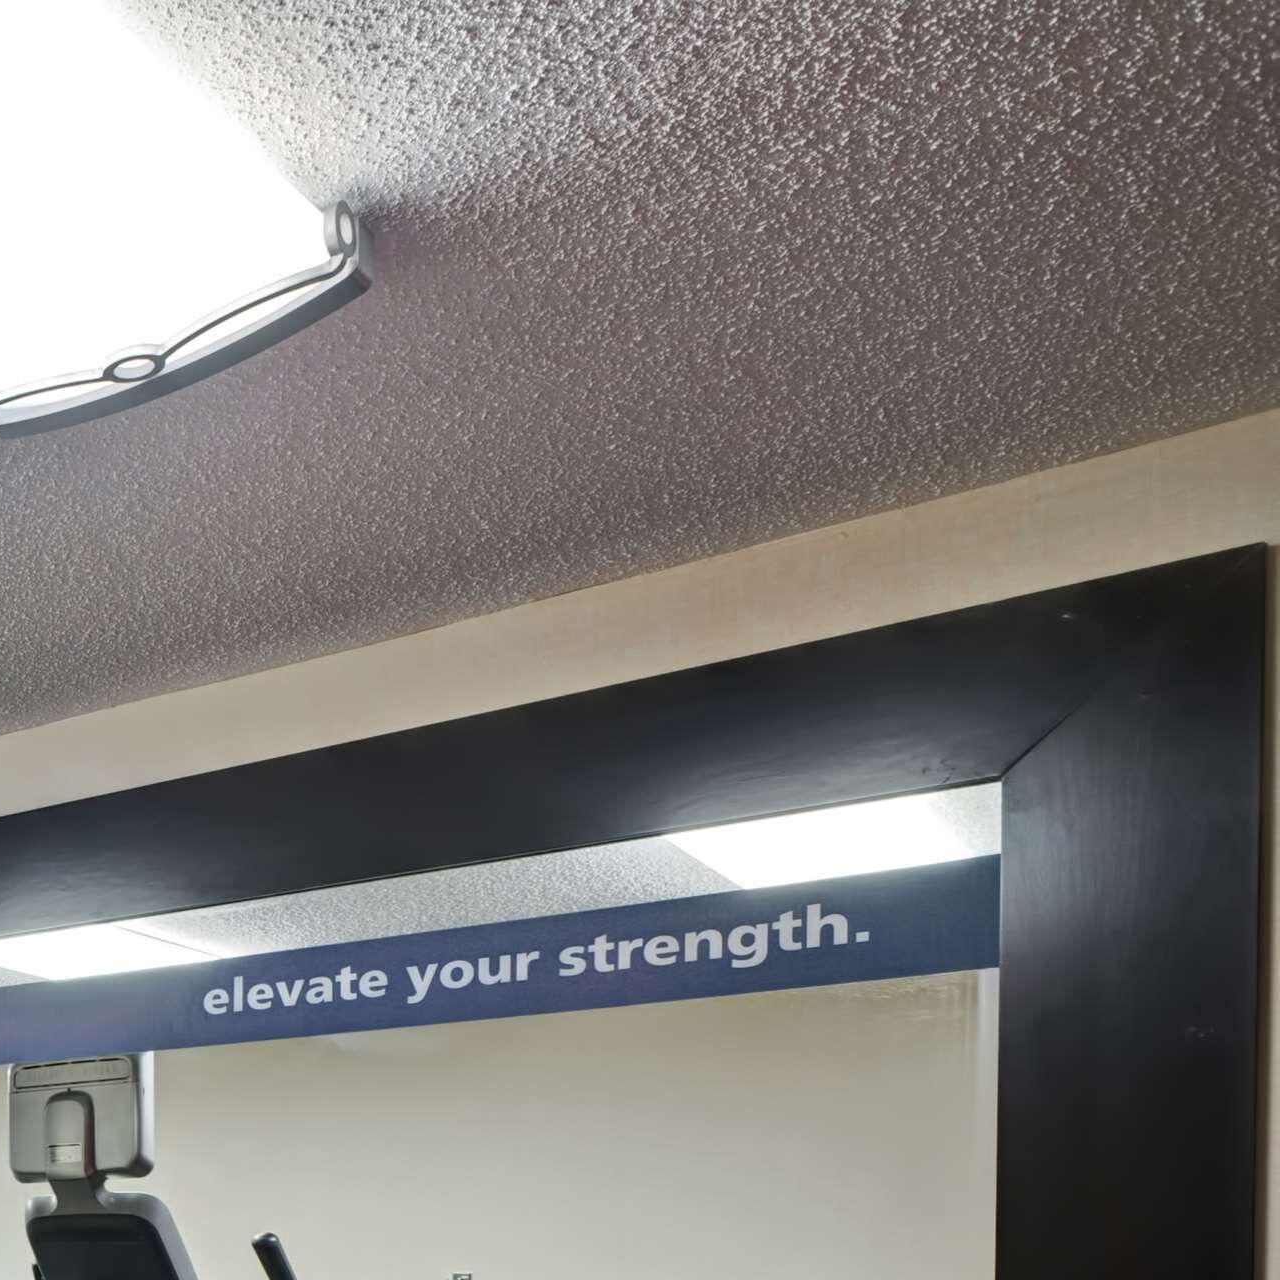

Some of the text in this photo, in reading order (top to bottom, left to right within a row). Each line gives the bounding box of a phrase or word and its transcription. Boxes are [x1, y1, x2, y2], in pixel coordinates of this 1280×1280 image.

[203, 903, 870, 1015] elevate your strength.
